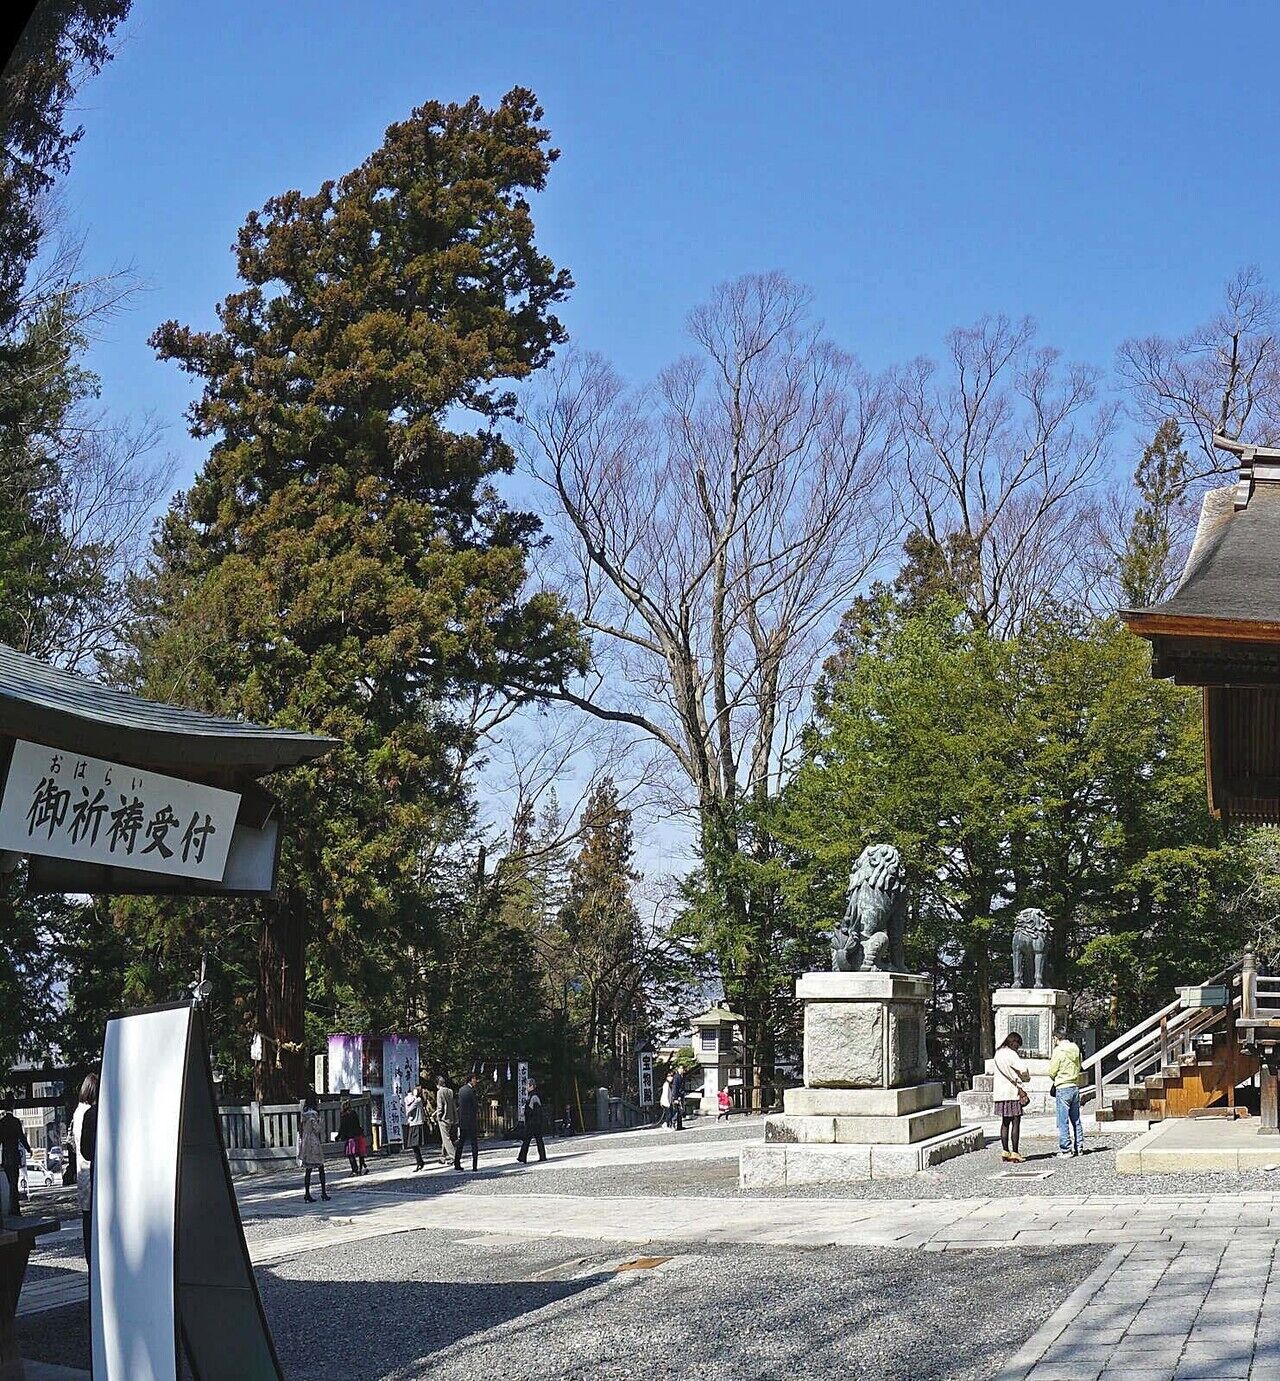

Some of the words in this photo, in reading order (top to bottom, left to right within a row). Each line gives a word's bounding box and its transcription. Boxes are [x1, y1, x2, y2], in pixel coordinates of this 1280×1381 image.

[50, 754, 143, 791] おはらい
[26, 776, 216, 864] 御祈祷受付
